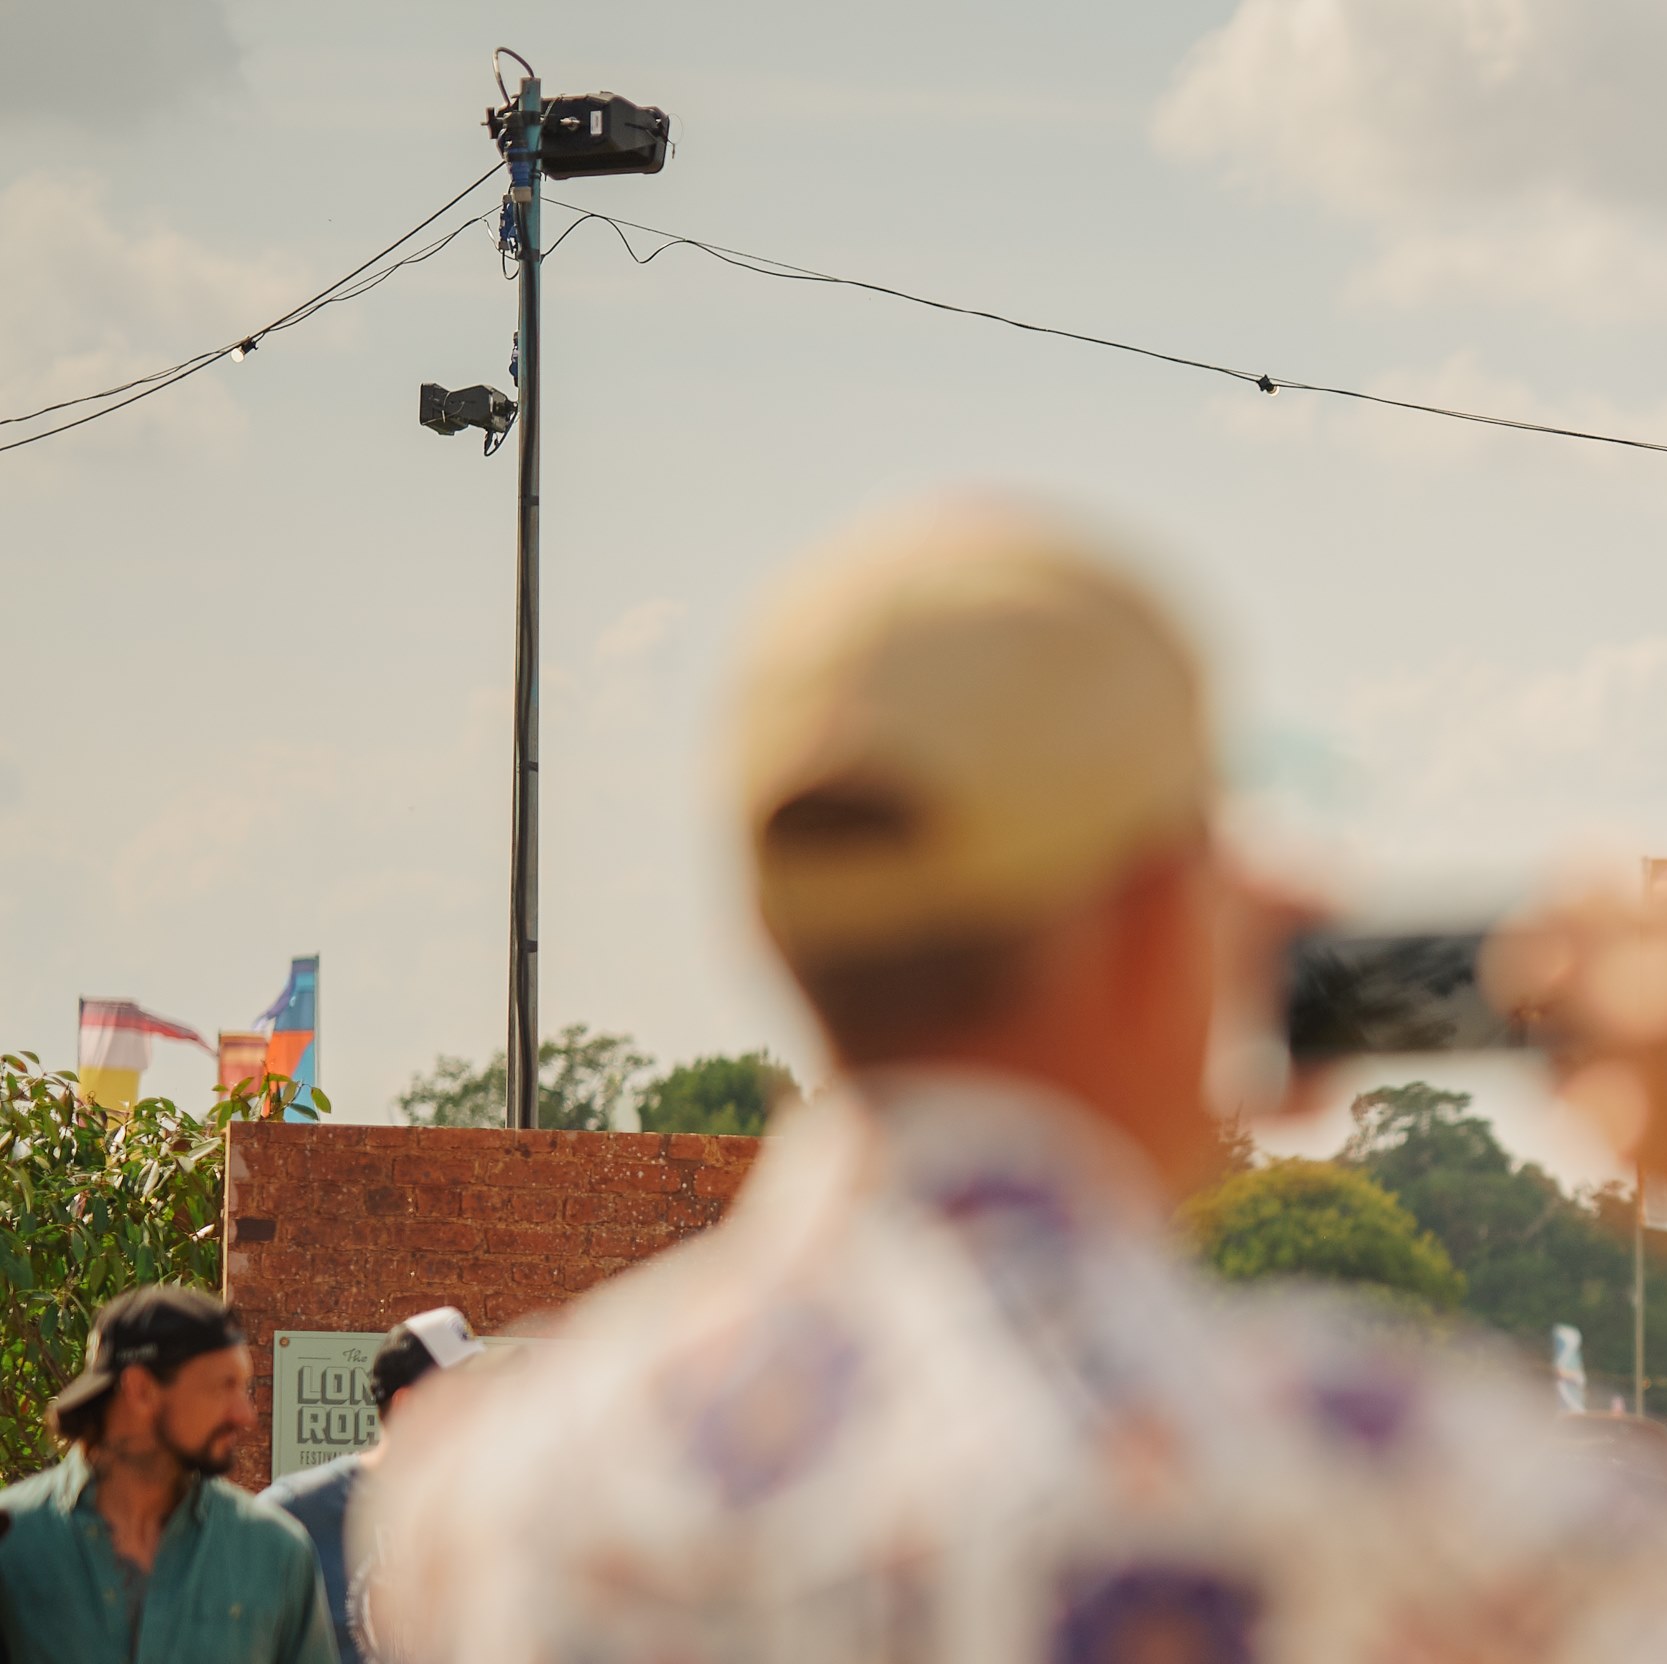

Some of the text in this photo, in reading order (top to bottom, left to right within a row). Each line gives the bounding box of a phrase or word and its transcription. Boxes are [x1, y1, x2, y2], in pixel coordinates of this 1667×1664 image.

[342, 1347, 368, 1363] The
[297, 1366, 377, 1405] LON
[297, 1406, 381, 1446] ROA
